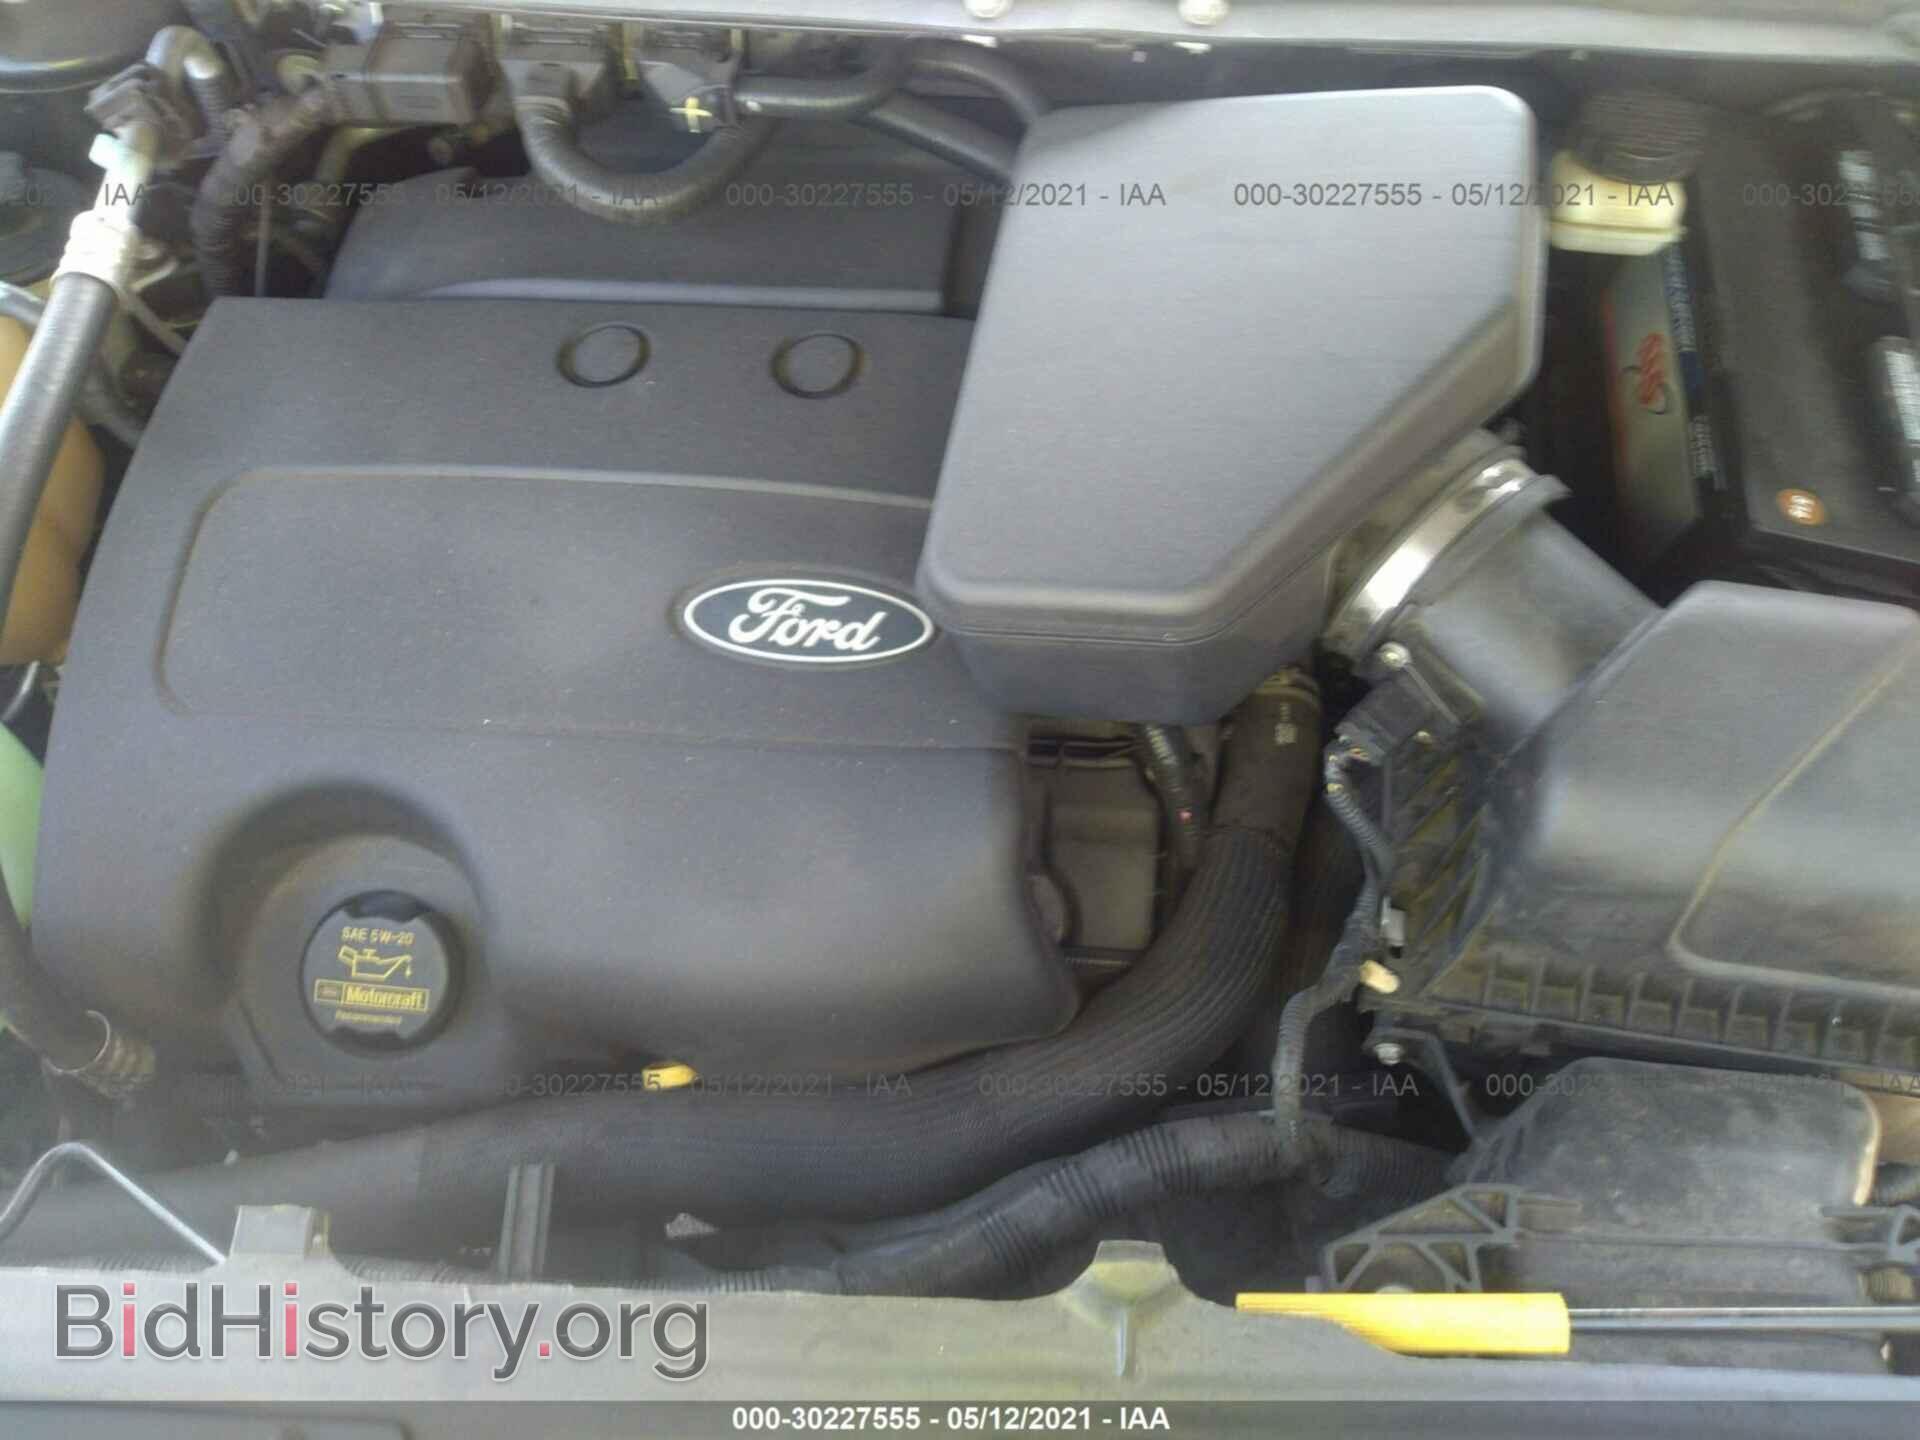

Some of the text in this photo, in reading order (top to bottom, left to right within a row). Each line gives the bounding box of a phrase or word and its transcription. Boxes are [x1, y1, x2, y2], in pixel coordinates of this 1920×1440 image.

[728, 588, 887, 650] Ford
[342, 927, 415, 945] SAE 5W-20
